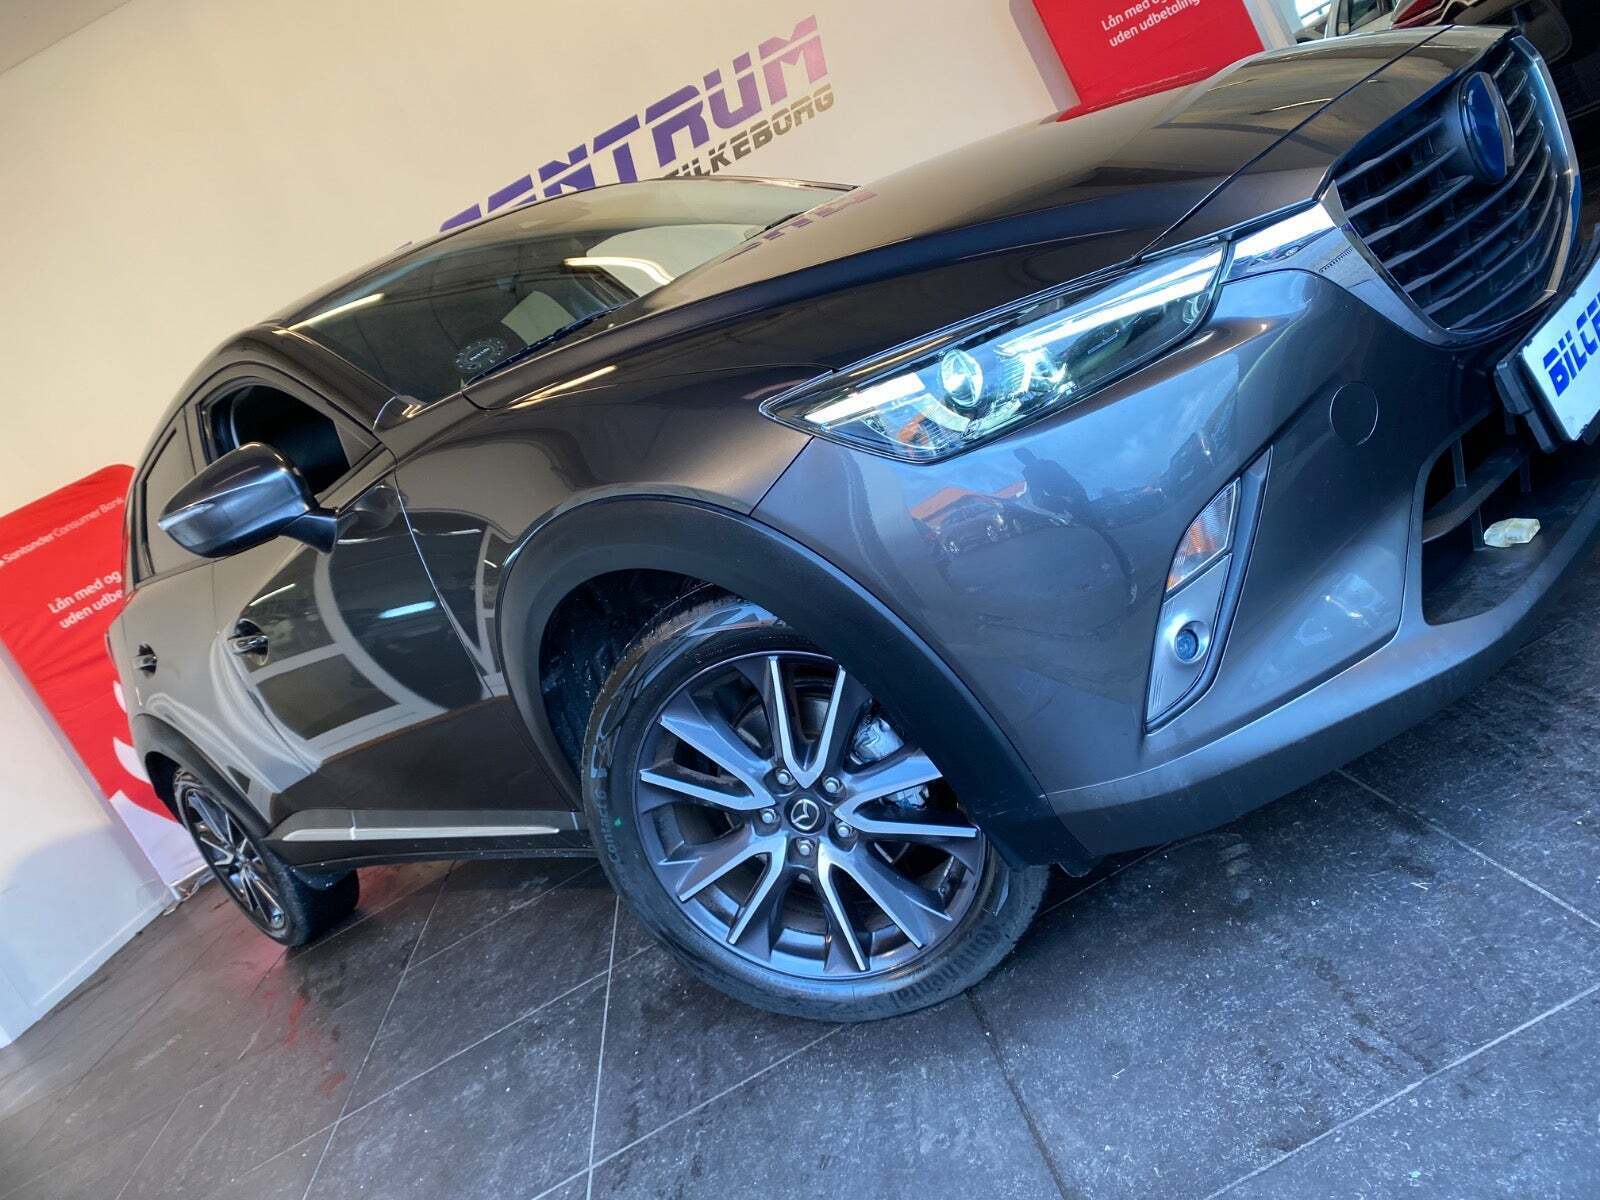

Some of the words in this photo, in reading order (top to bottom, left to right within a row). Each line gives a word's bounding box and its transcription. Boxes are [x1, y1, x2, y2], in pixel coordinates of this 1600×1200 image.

[1101, 14, 1124, 31] Lån
[1124, 0, 1151, 19] med
[1109, 26, 1138, 47] uden
[439, 14, 828, 232] NTRUM
[664, 84, 834, 177] ILKEBORG
[1543, 291, 1600, 398] BILCE
[2, 533, 55, 563] Santander
[48, 597, 75, 613] Lån
[74, 578, 104, 601] med
[104, 571, 122, 584] og
[59, 605, 93, 628] uden
